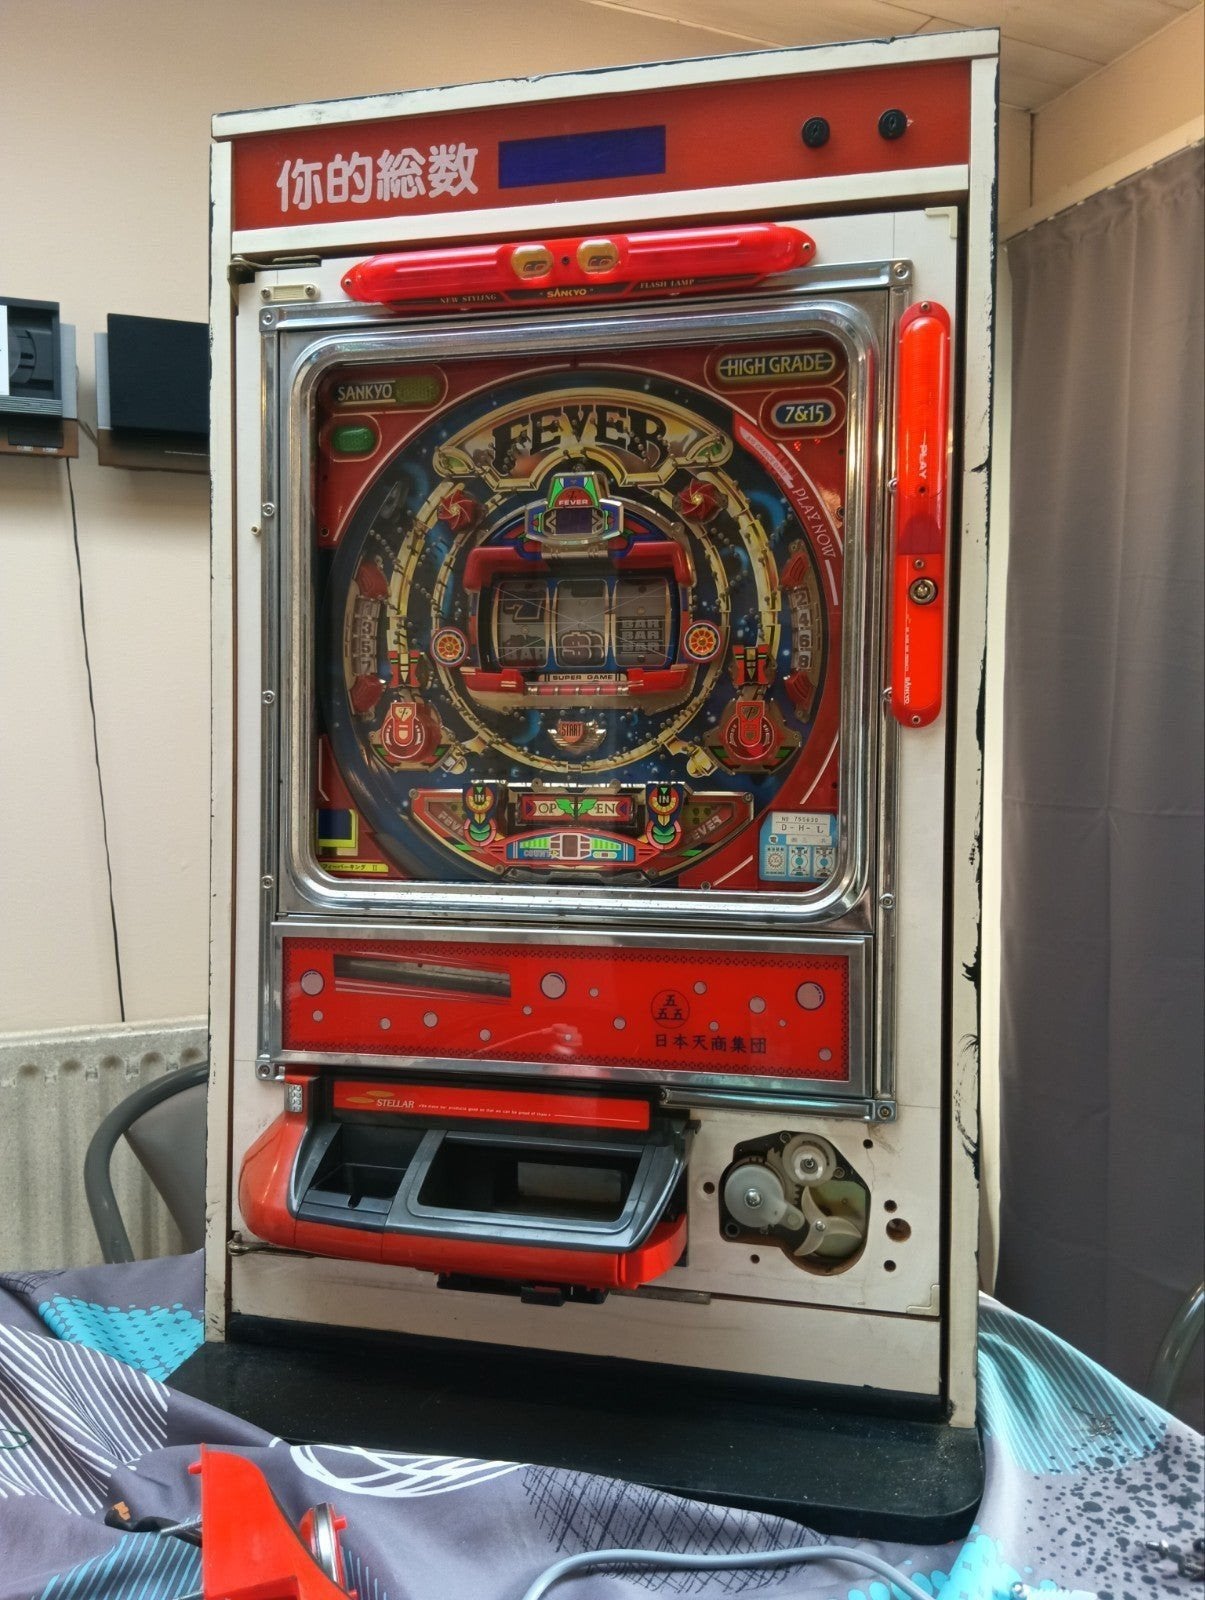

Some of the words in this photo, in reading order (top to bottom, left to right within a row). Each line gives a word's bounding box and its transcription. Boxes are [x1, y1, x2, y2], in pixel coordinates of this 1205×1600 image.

[275, 142, 479, 212] 你的総数
[547, 288, 587, 298] SANKYO
[640, 281, 667, 289] FLASH
[671, 279, 695, 287] LAMP
[727, 358, 766, 376] HIGH
[769, 354, 824, 374] GRADE
[337, 384, 393, 401] SANKYO
[785, 404, 824, 425] 7&15
[492, 404, 670, 476] FEVER
[918, 444, 928, 480] PLAY
[792, 487, 820, 521] PLAY
[812, 523, 836, 558] NOW
[561, 723, 581, 737] START
[474, 794, 485, 802] IN
[659, 795, 669, 803] IN
[655, 1033, 767, 1054] 日本天商集団
[376, 1098, 415, 1109] STELLAR
